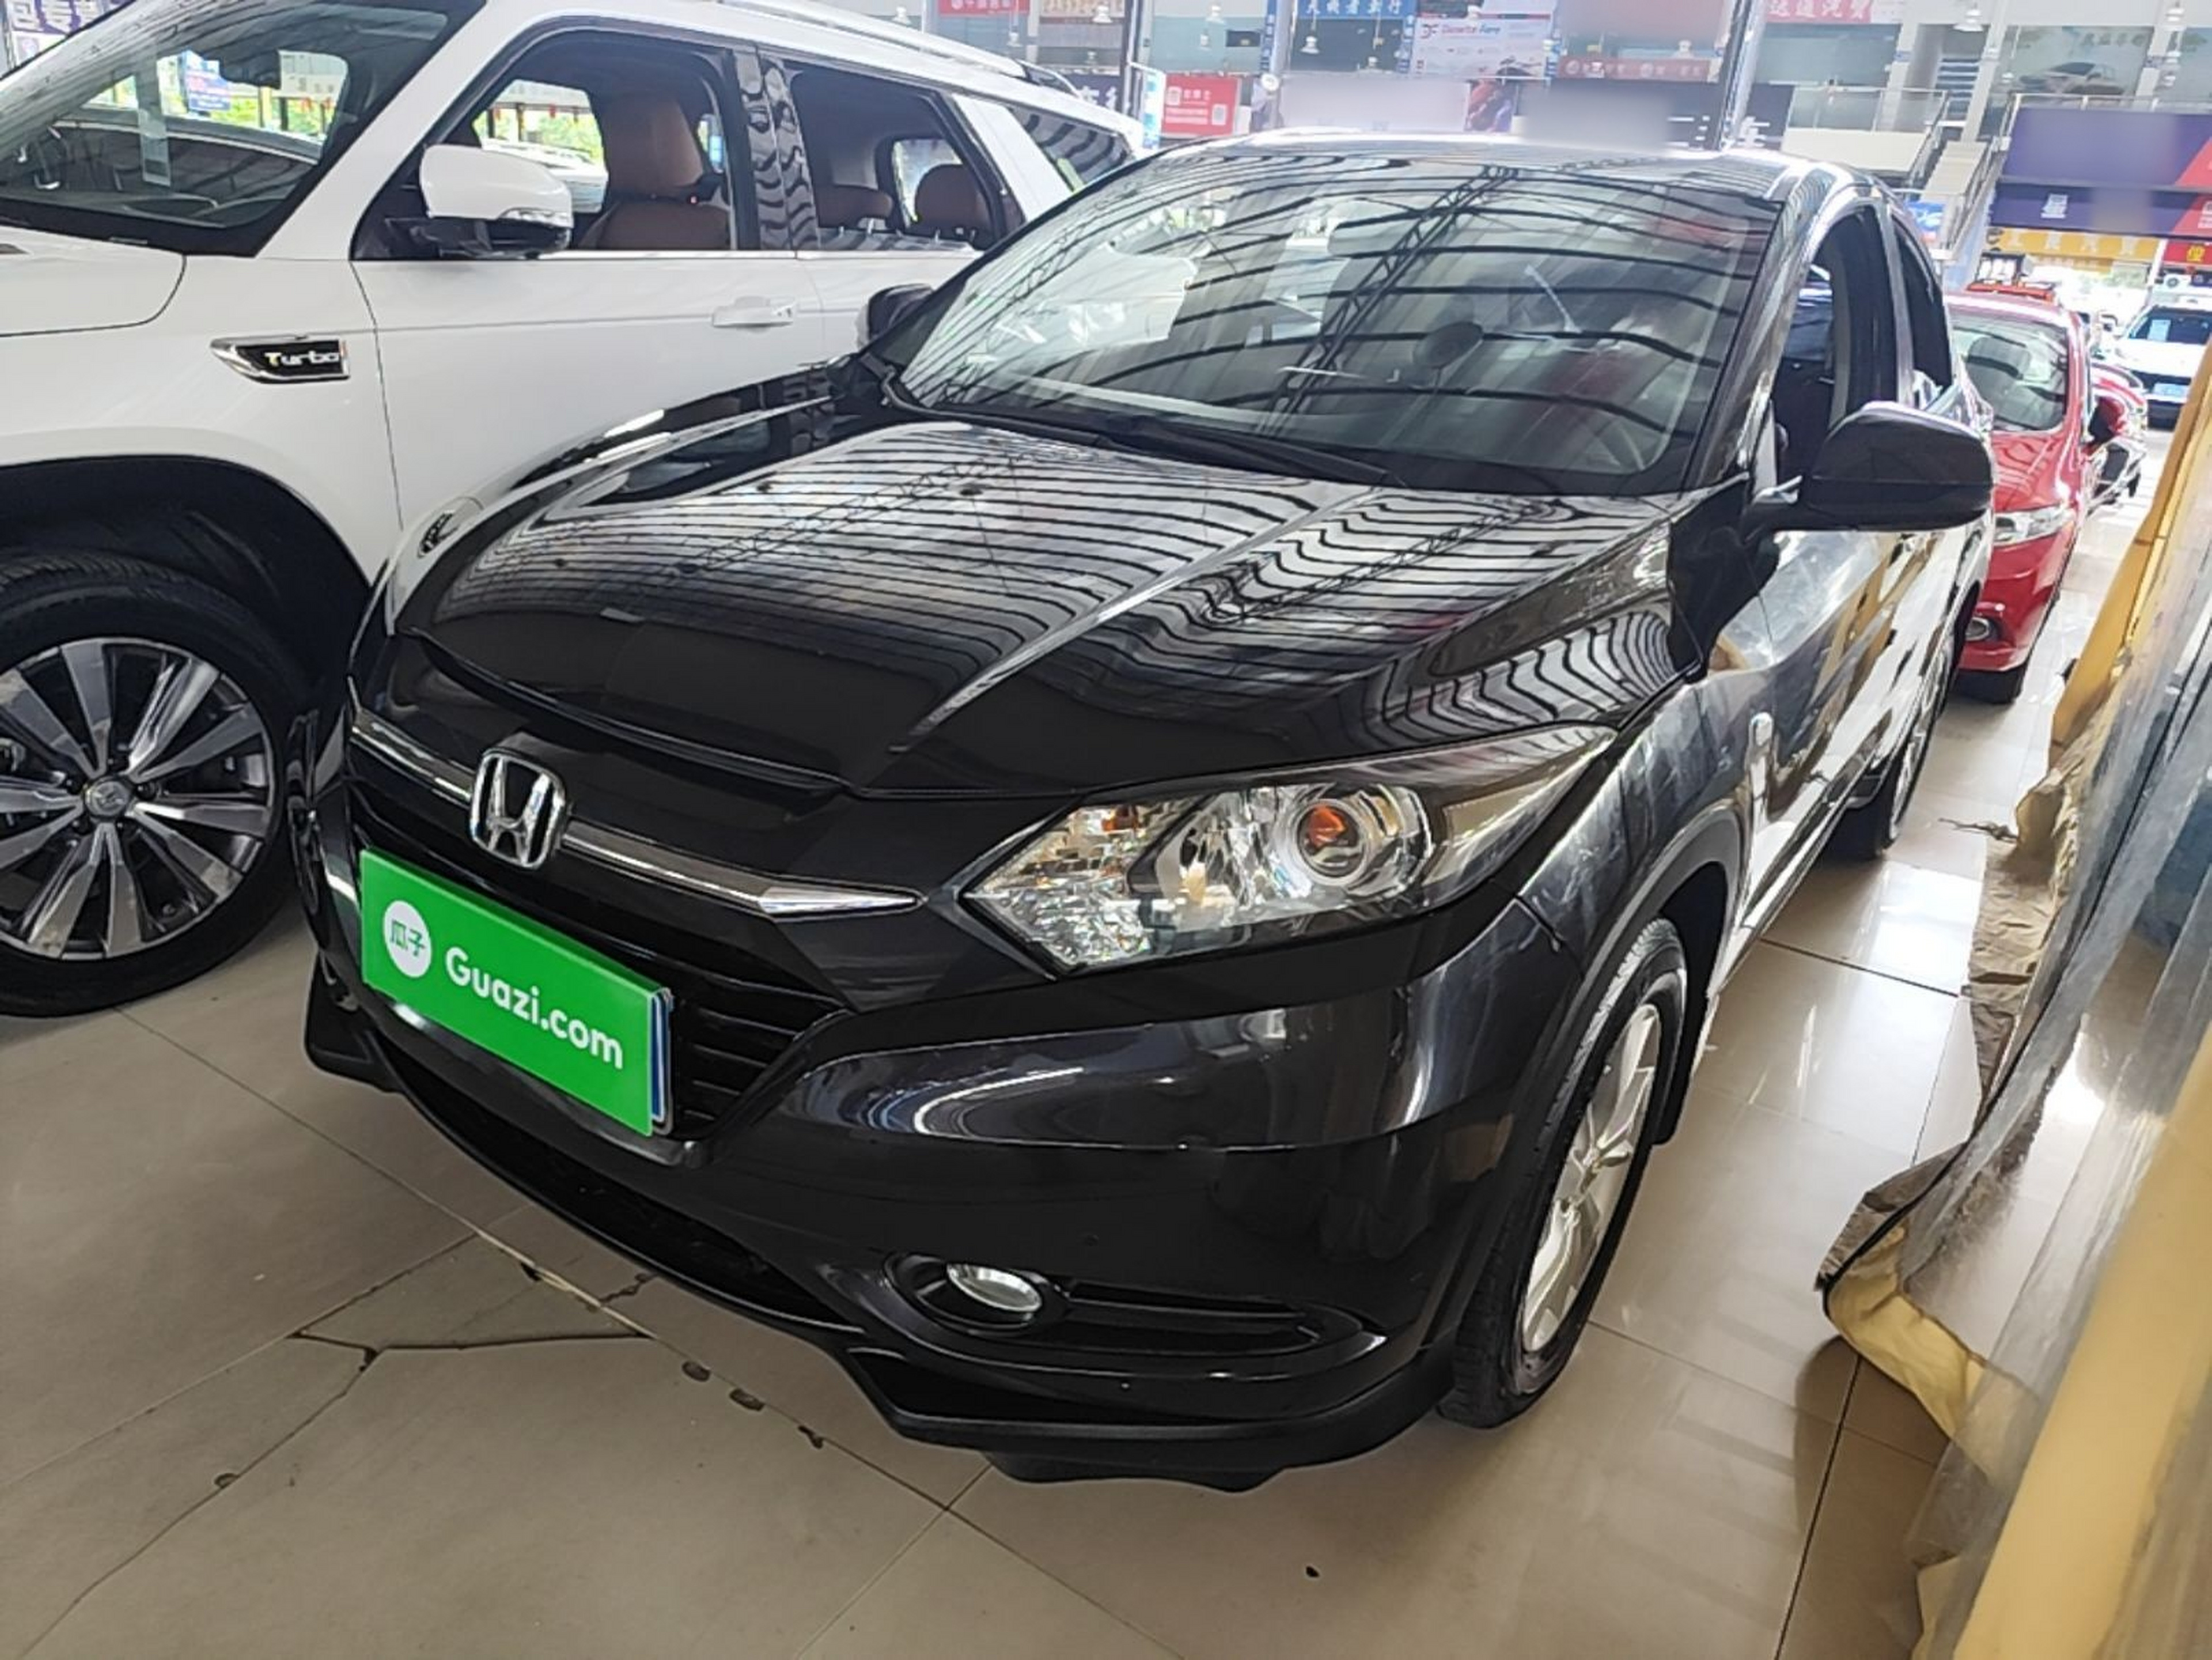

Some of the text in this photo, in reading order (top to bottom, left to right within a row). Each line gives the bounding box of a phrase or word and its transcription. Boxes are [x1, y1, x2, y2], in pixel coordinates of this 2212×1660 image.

[264, 350, 339, 366] Turbo
[391, 918, 426, 956] 瓜子
[445, 947, 623, 1069] Guazi.com
